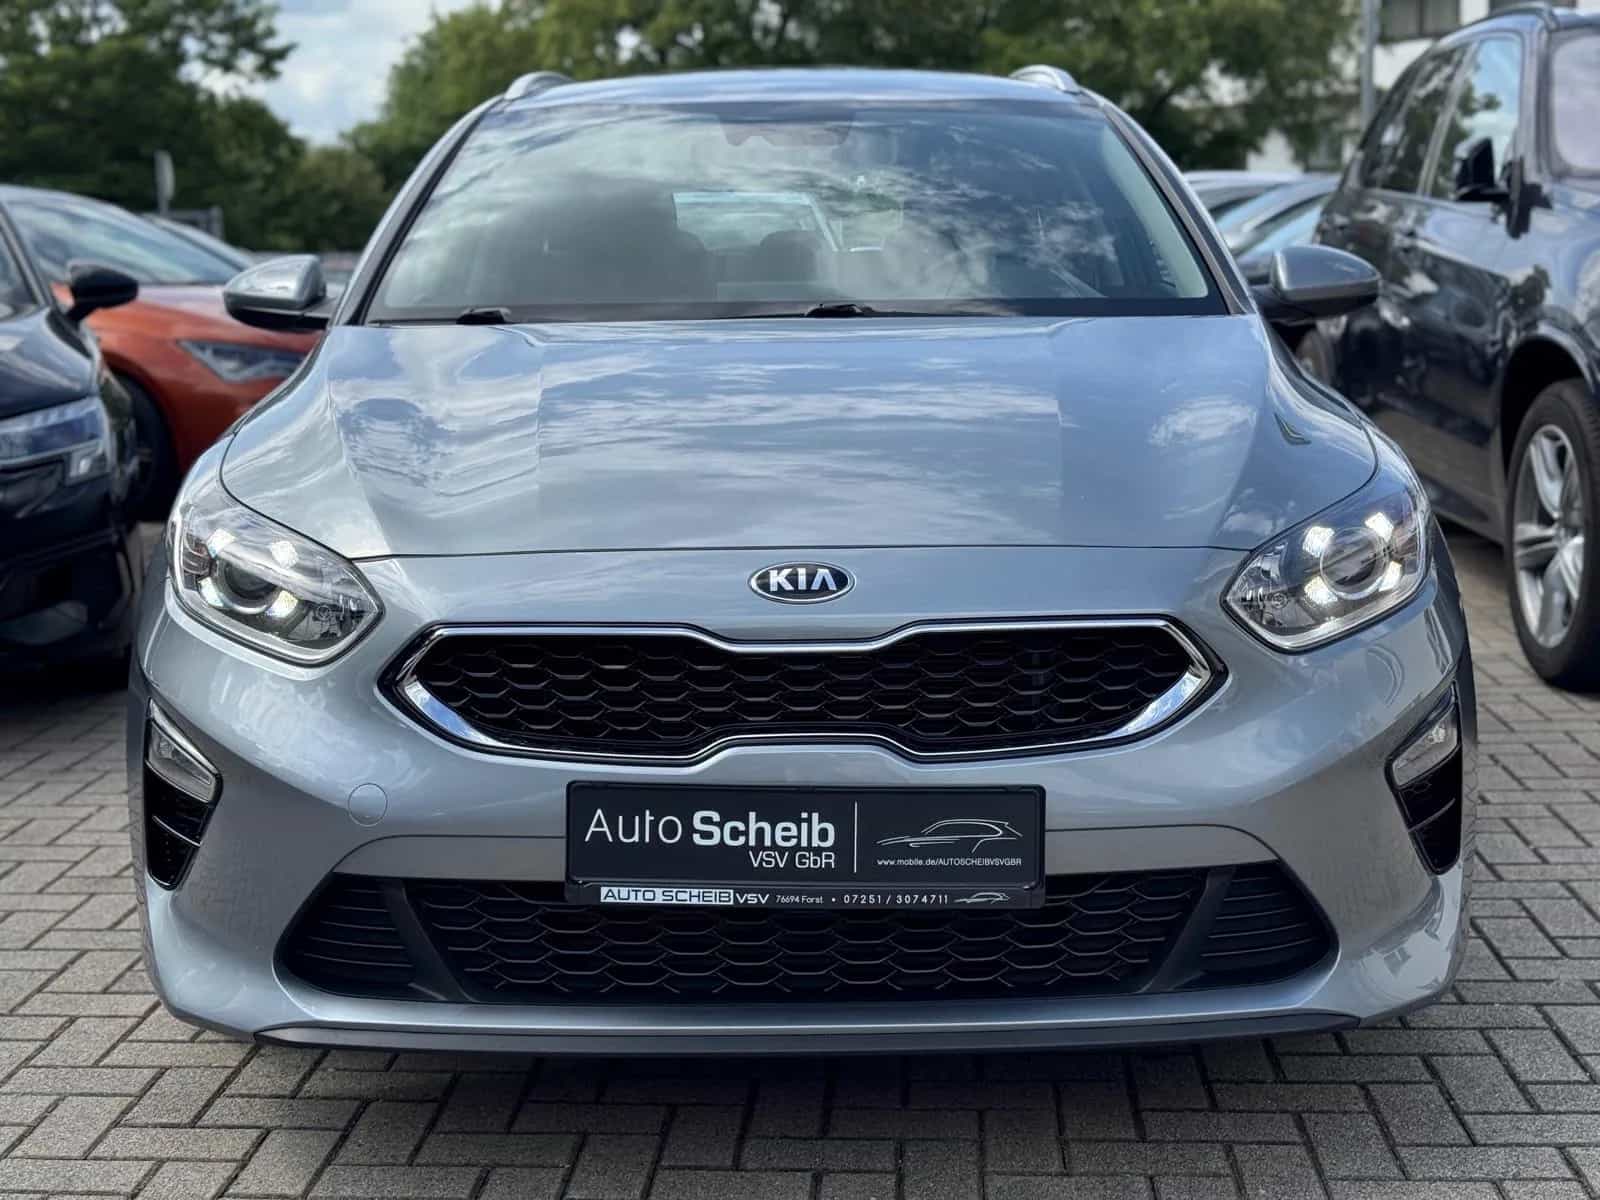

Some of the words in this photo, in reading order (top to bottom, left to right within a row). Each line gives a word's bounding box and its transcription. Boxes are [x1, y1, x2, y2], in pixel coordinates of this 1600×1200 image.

[768, 567, 837, 592] KIA
[584, 808, 682, 844] Auto
[692, 810, 835, 848] Scheib
[748, 850, 788, 869] VSV
[795, 851, 835, 870] GbR
[877, 857, 1022, 867] www.mobile.de/AUTOSCHEIBVSVGBR
[603, 888, 656, 901] AUTO
[661, 889, 732, 903] SCHEIB
[735, 893, 770, 904] VSV
[775, 894, 800, 904] 76694
[801, 895, 824, 904] Forst
[843, 894, 881, 904] 07251
[896, 894, 949, 904] 3074711
